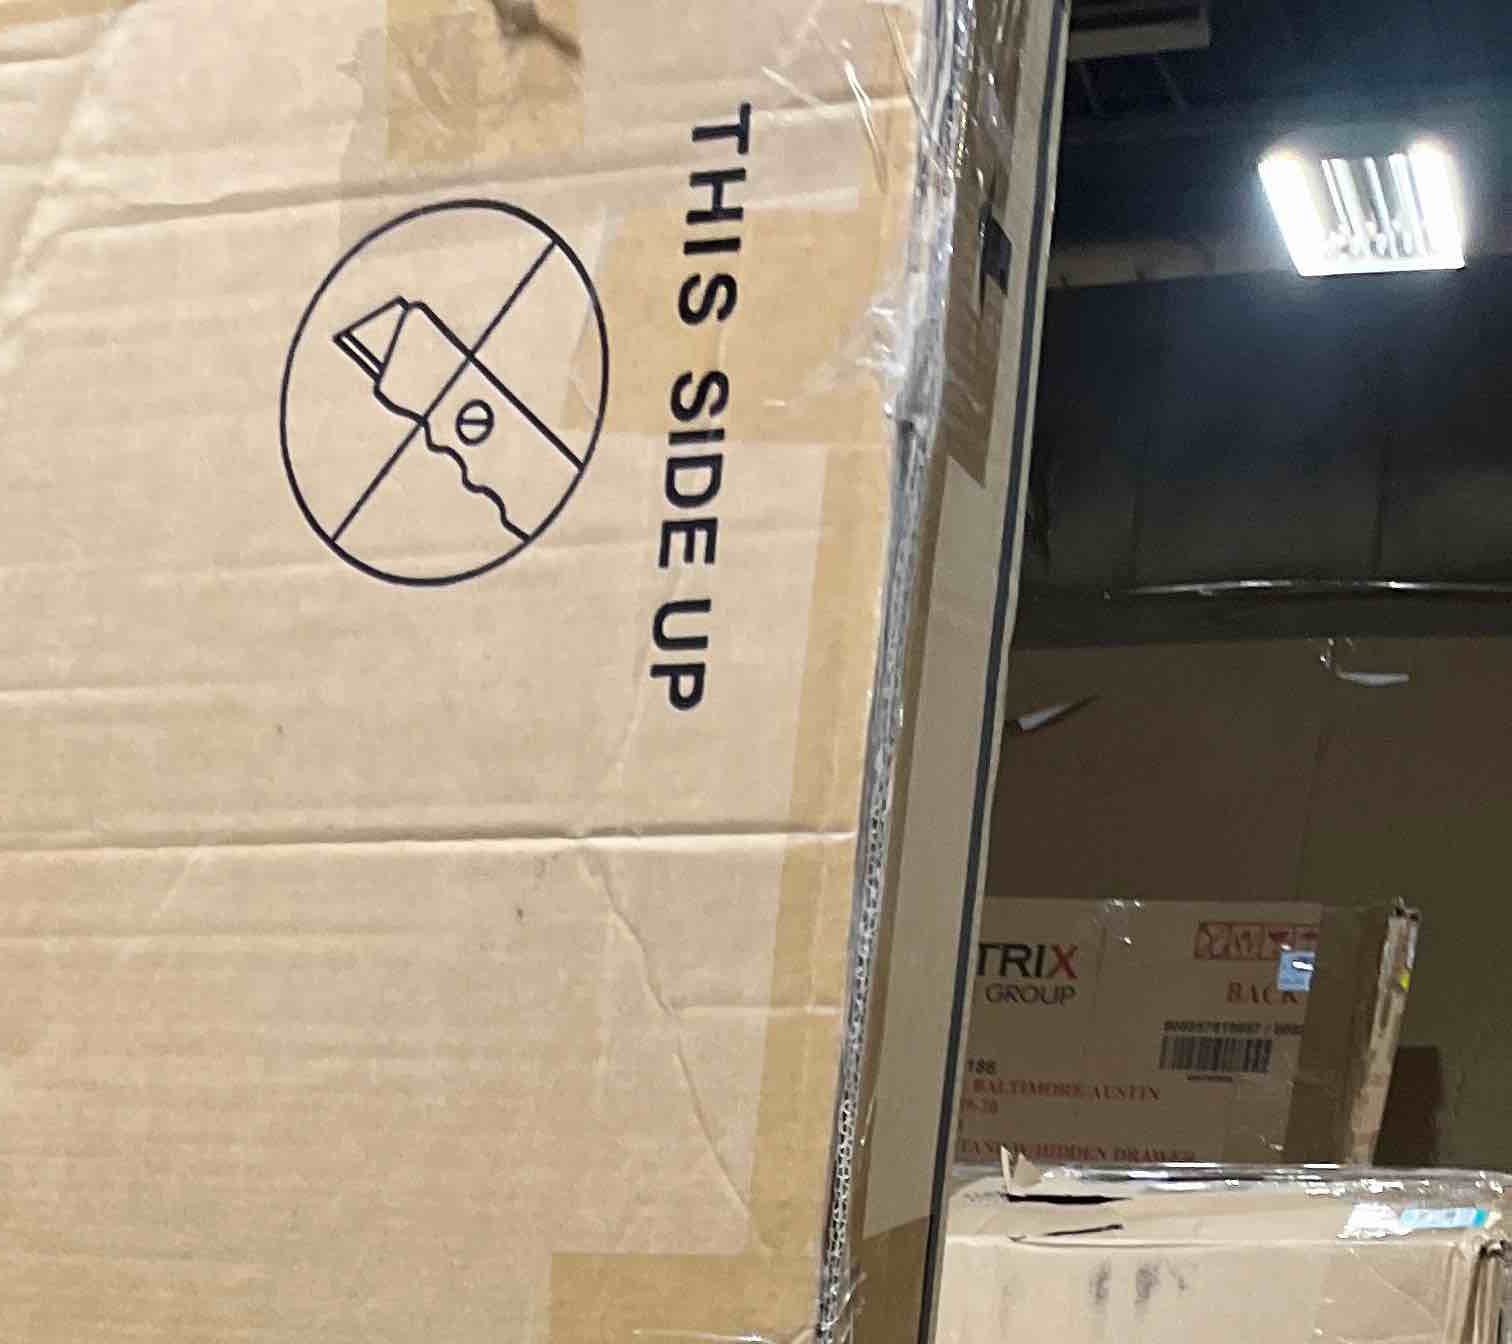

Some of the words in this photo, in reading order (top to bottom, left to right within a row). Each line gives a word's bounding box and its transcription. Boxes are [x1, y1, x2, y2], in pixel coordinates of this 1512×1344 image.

[678, 103, 751, 324] THIS
[659, 371, 729, 568] SIDE
[651, 599, 711, 710] UP
[984, 983, 1076, 1005] GROUP
